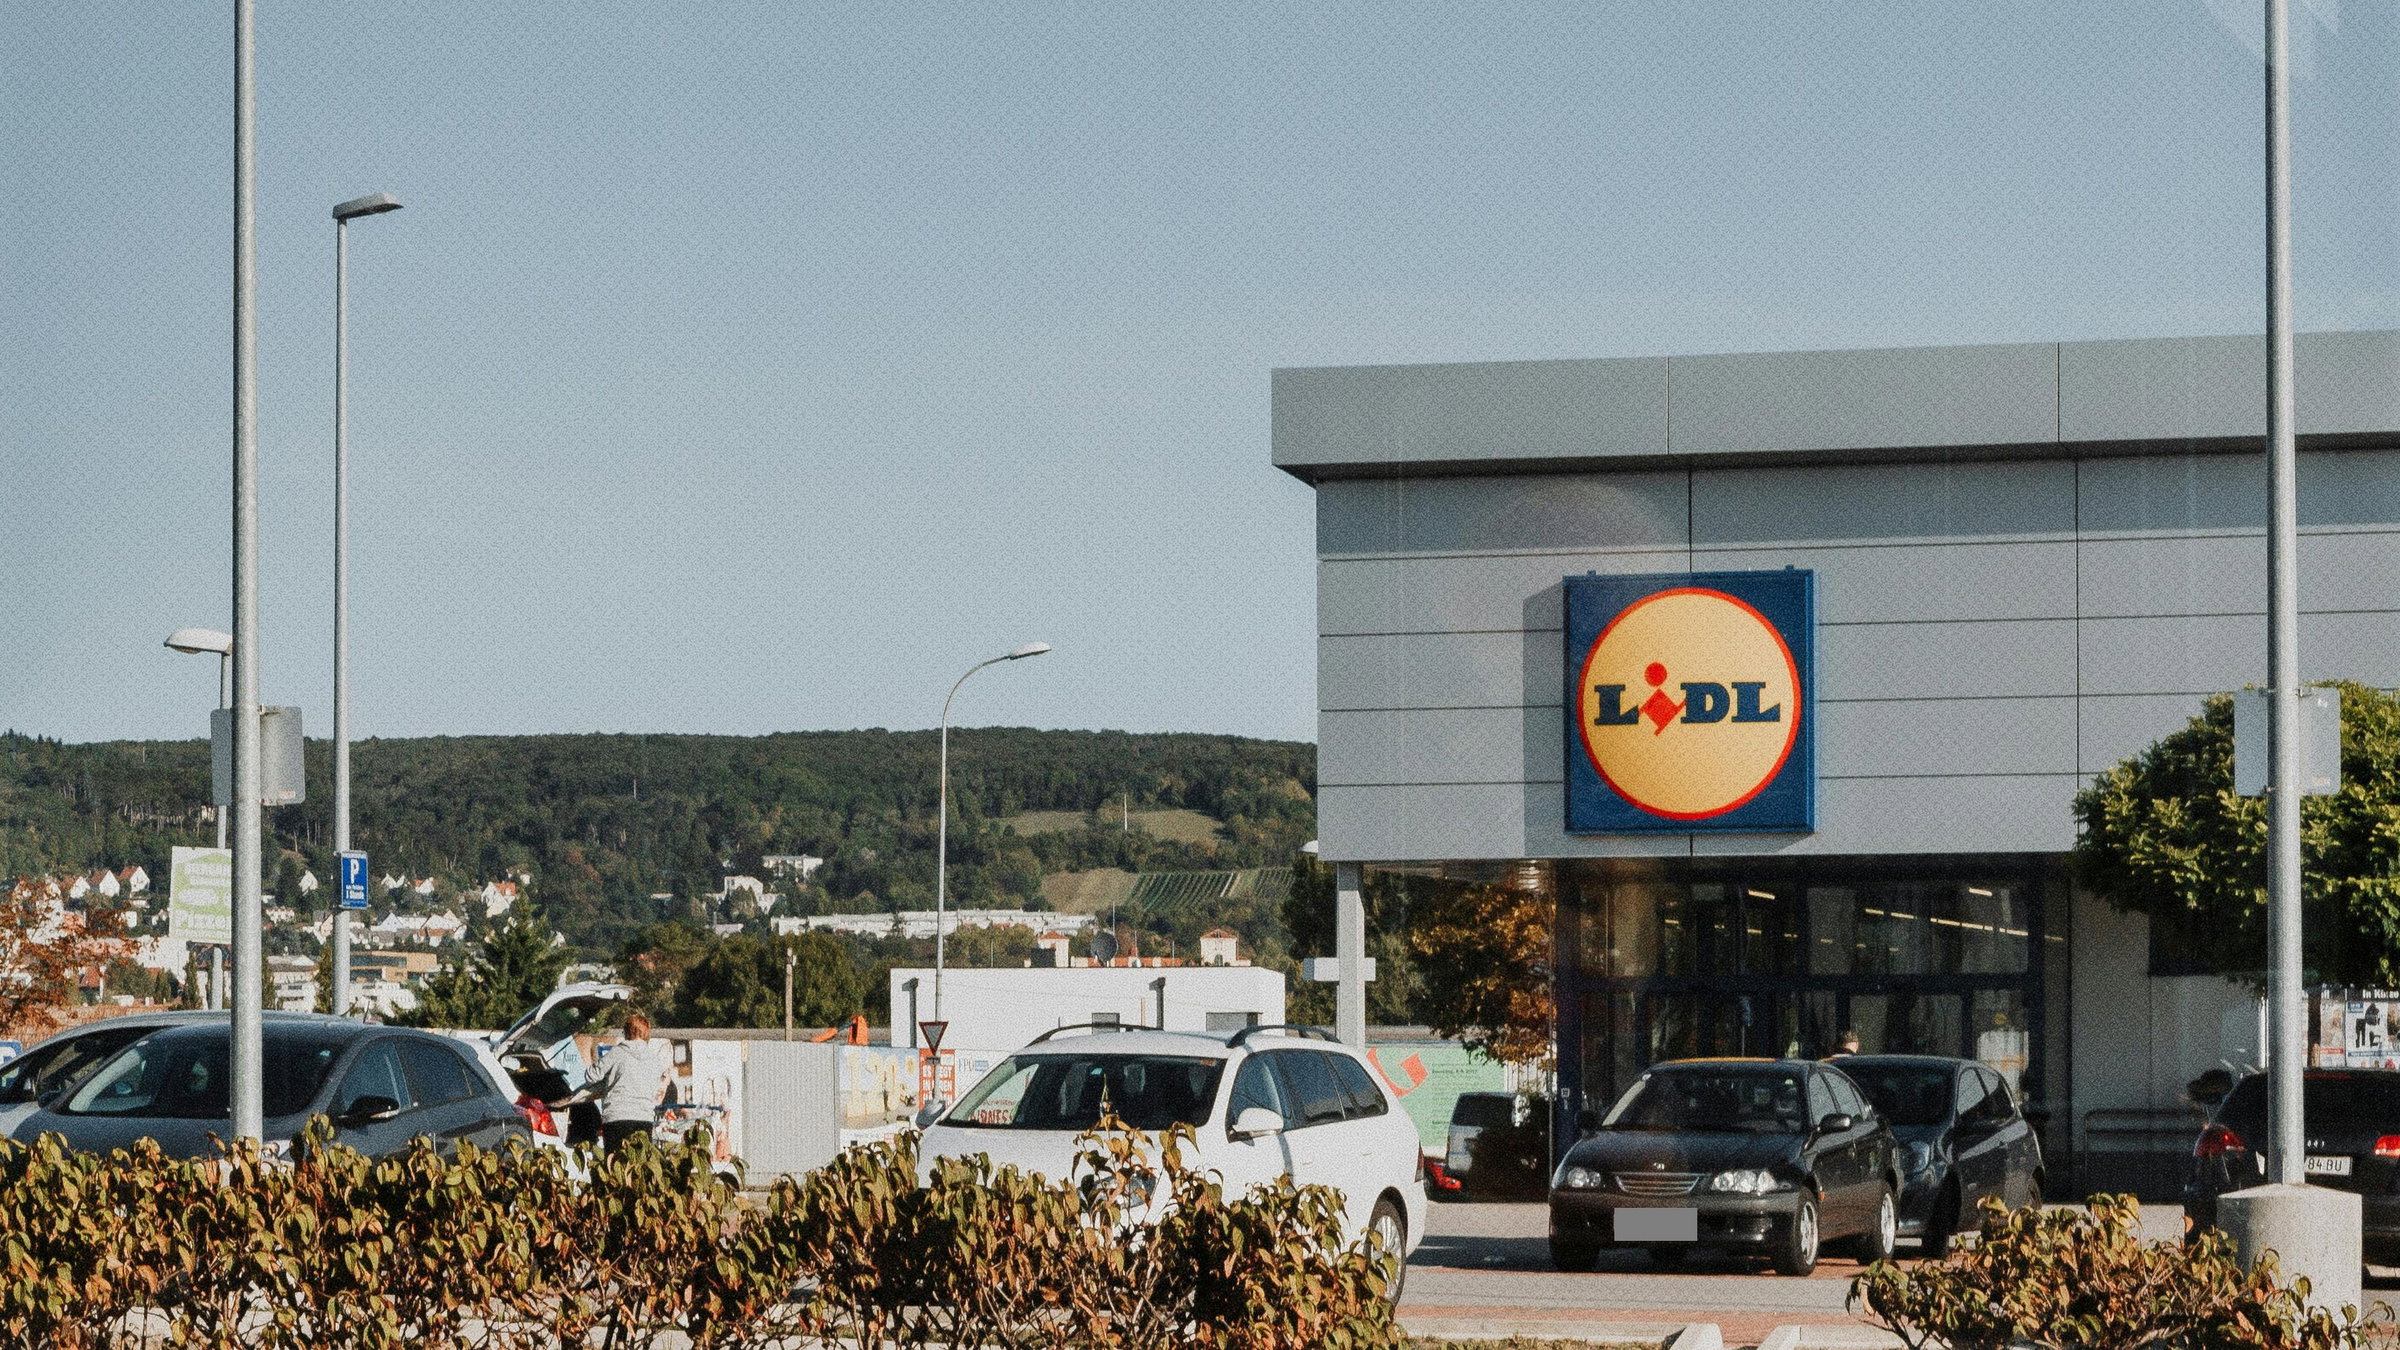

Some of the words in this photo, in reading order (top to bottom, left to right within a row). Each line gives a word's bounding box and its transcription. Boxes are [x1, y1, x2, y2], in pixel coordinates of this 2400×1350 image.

[350, 858, 360, 884] P
[2307, 1157, 2323, 1170] 84
[2326, 1159, 2342, 1172] BU
